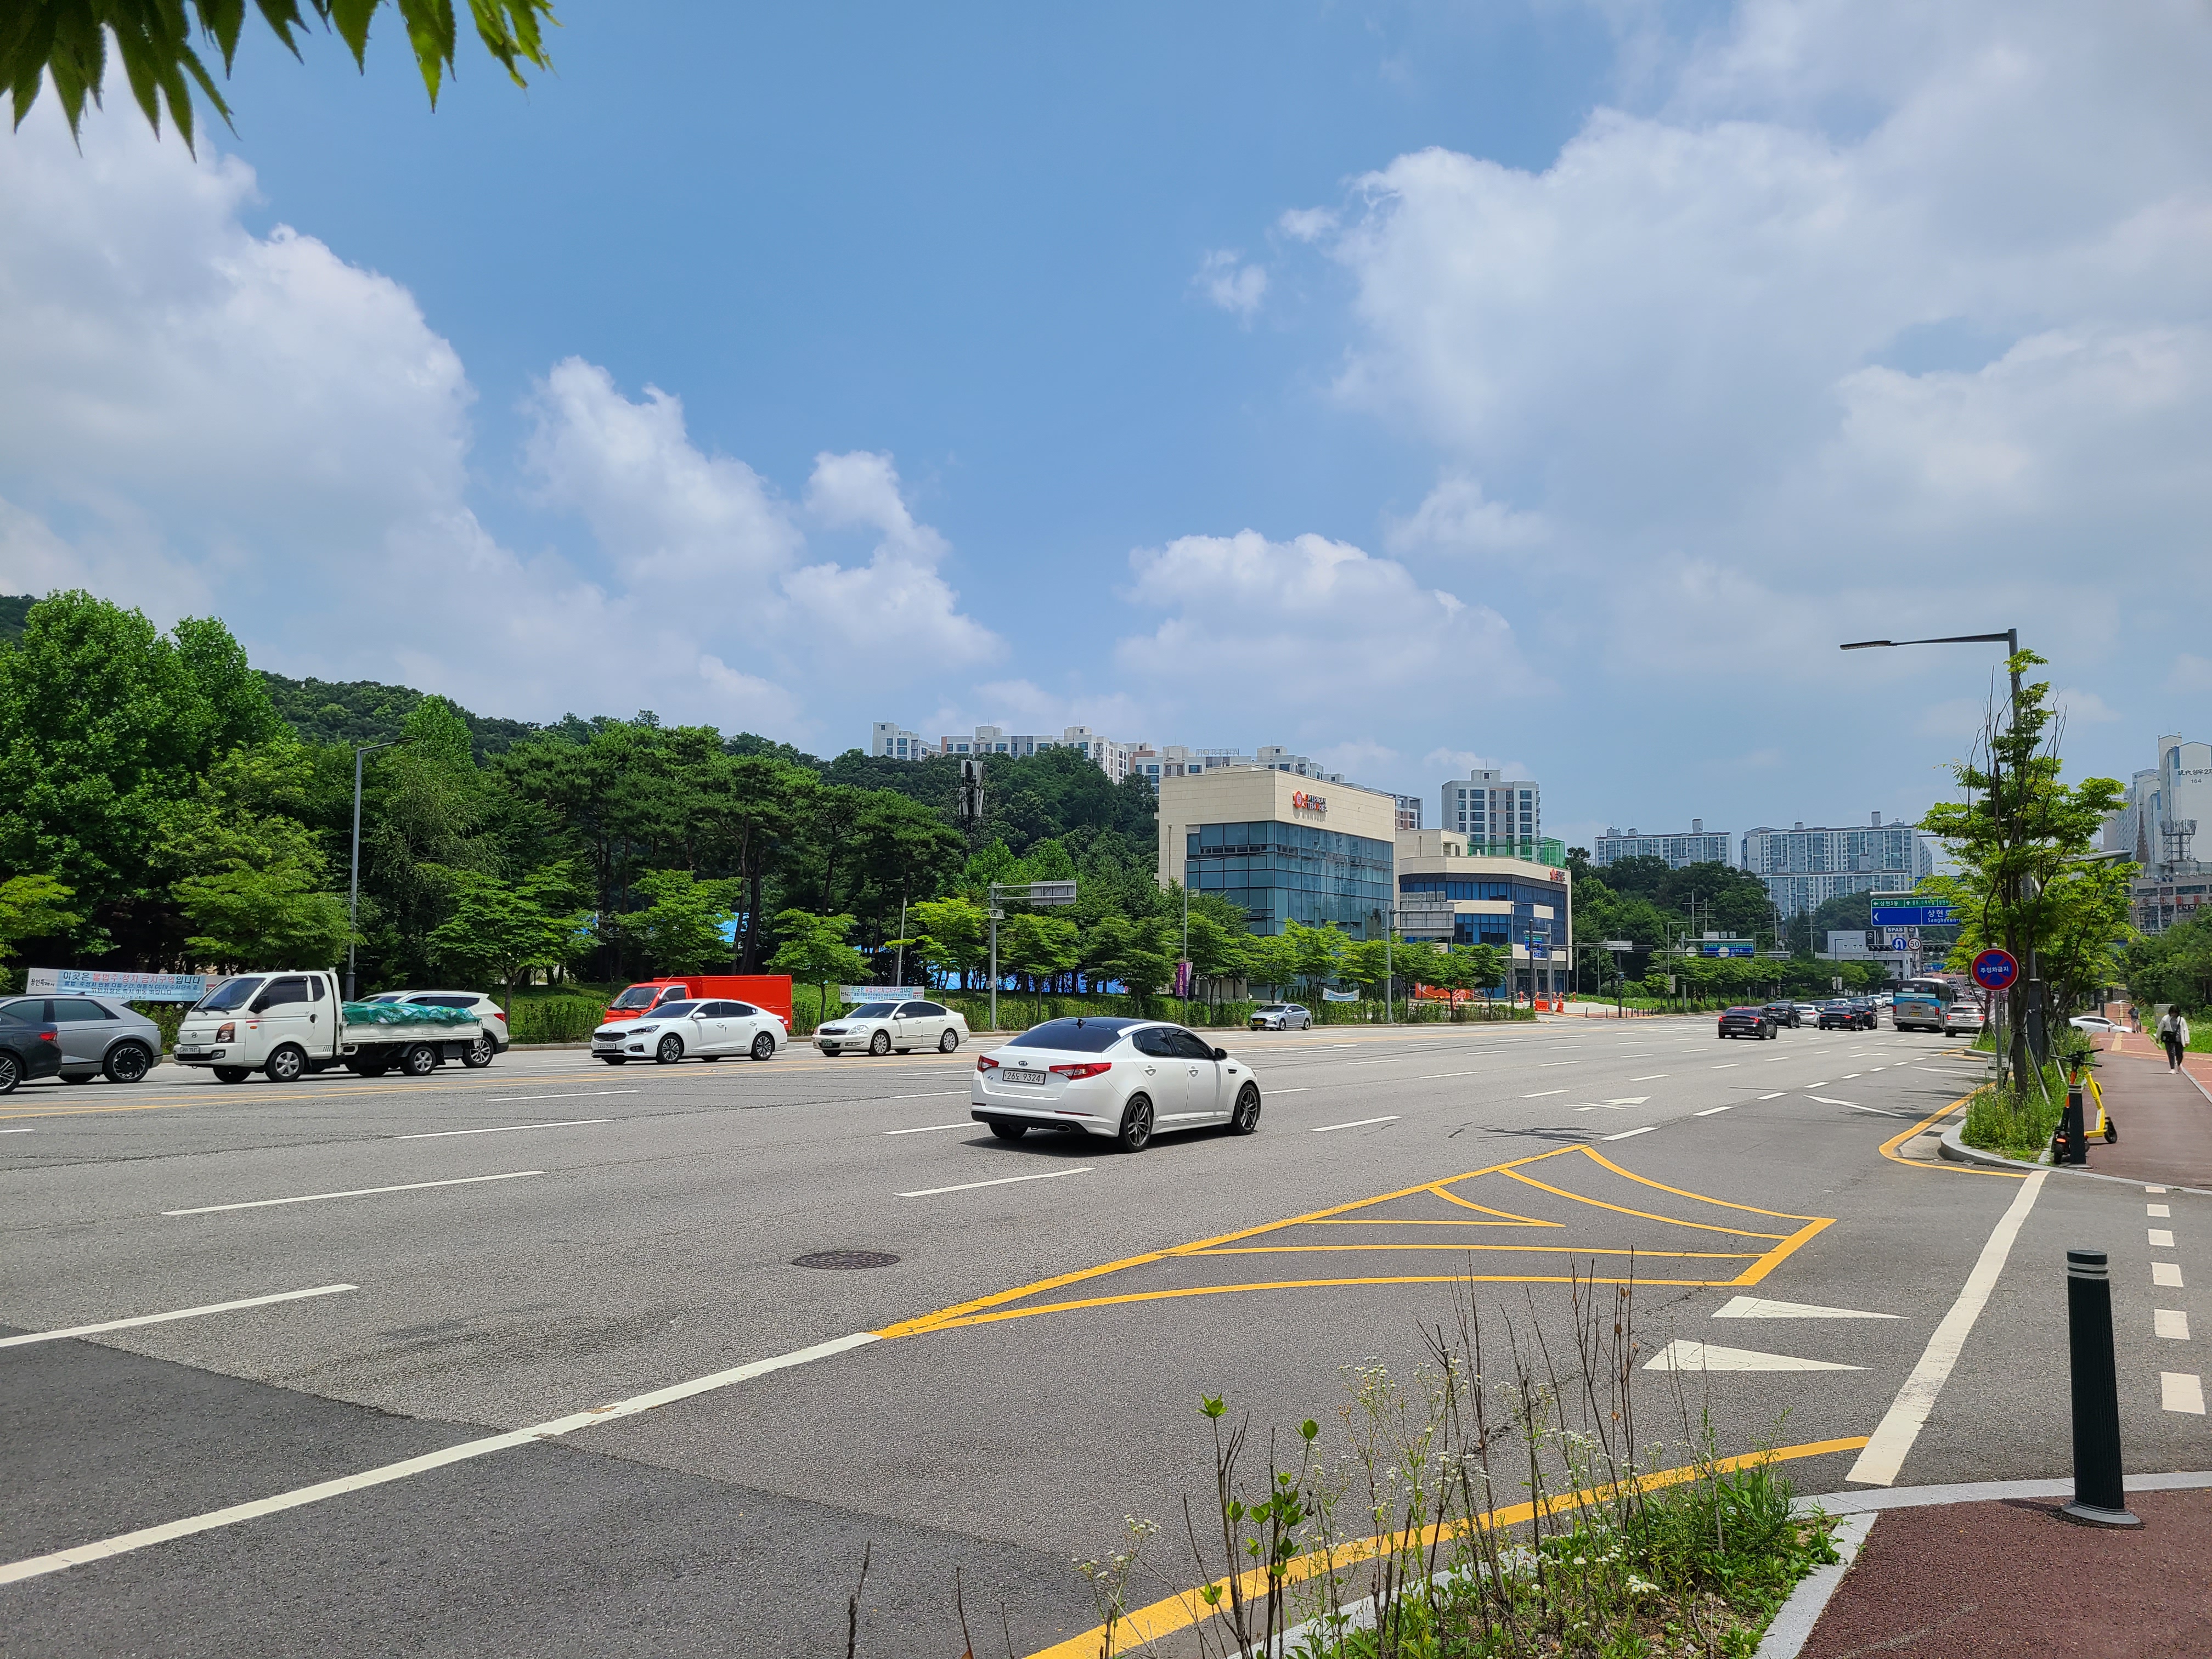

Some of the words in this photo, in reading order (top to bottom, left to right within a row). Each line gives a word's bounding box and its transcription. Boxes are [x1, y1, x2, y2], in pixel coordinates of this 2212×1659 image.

[63, 971, 89, 981] 이곳은
[142, 975, 200, 985] 금지구역입니다
[1023, 1073, 1041, 1082] 9324
